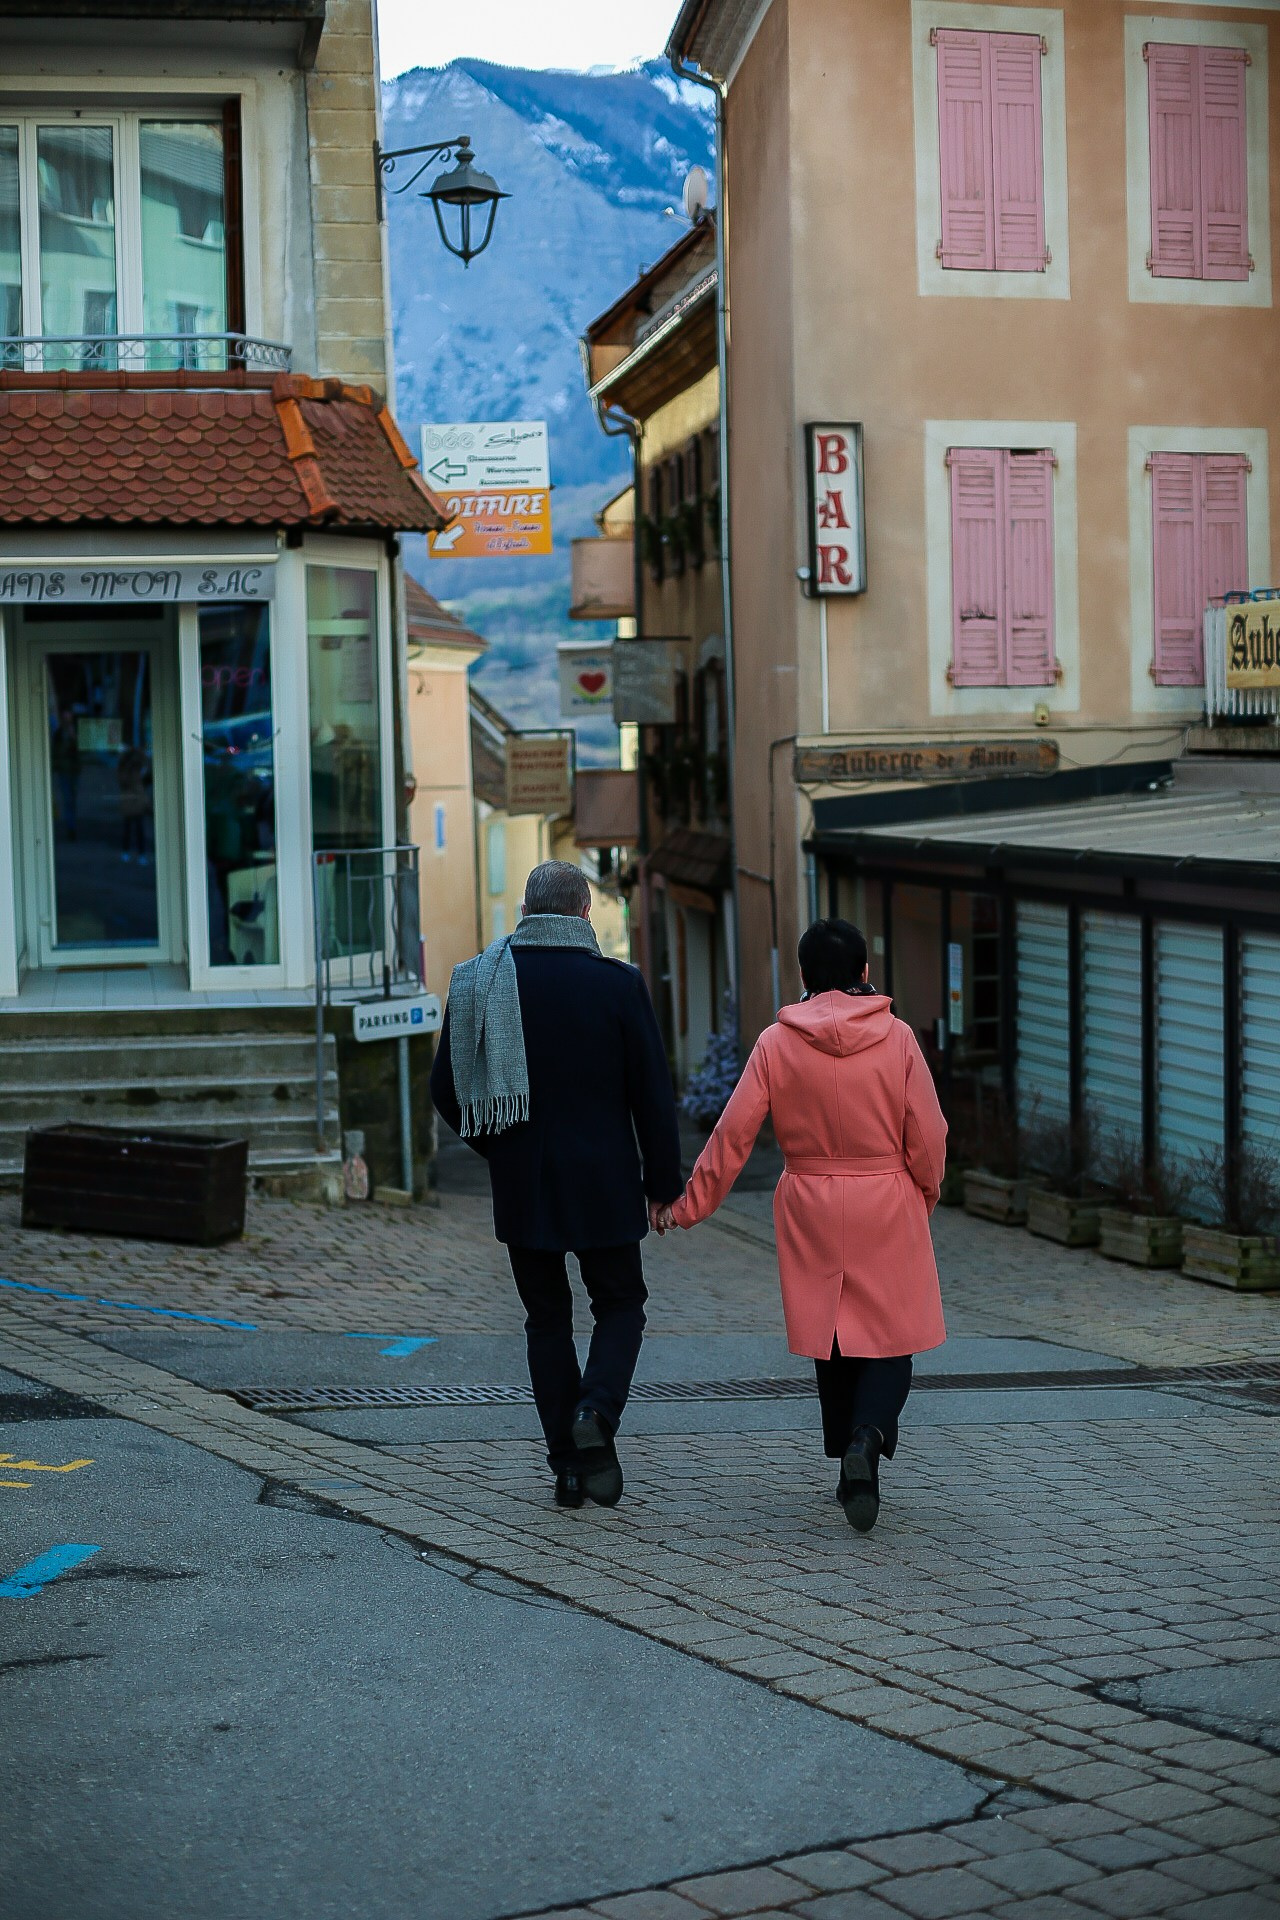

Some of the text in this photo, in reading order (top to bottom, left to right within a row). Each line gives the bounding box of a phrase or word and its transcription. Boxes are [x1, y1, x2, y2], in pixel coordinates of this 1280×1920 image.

[441, 493, 545, 518] OIFFURE
[816, 434, 853, 585] BAR
[81, 571, 182, 599] MON
[198, 570, 262, 597] SAC
[830, 749, 923, 776] Auberge
[936, 753, 954, 769] de
[359, 1011, 409, 1030] PARKING
